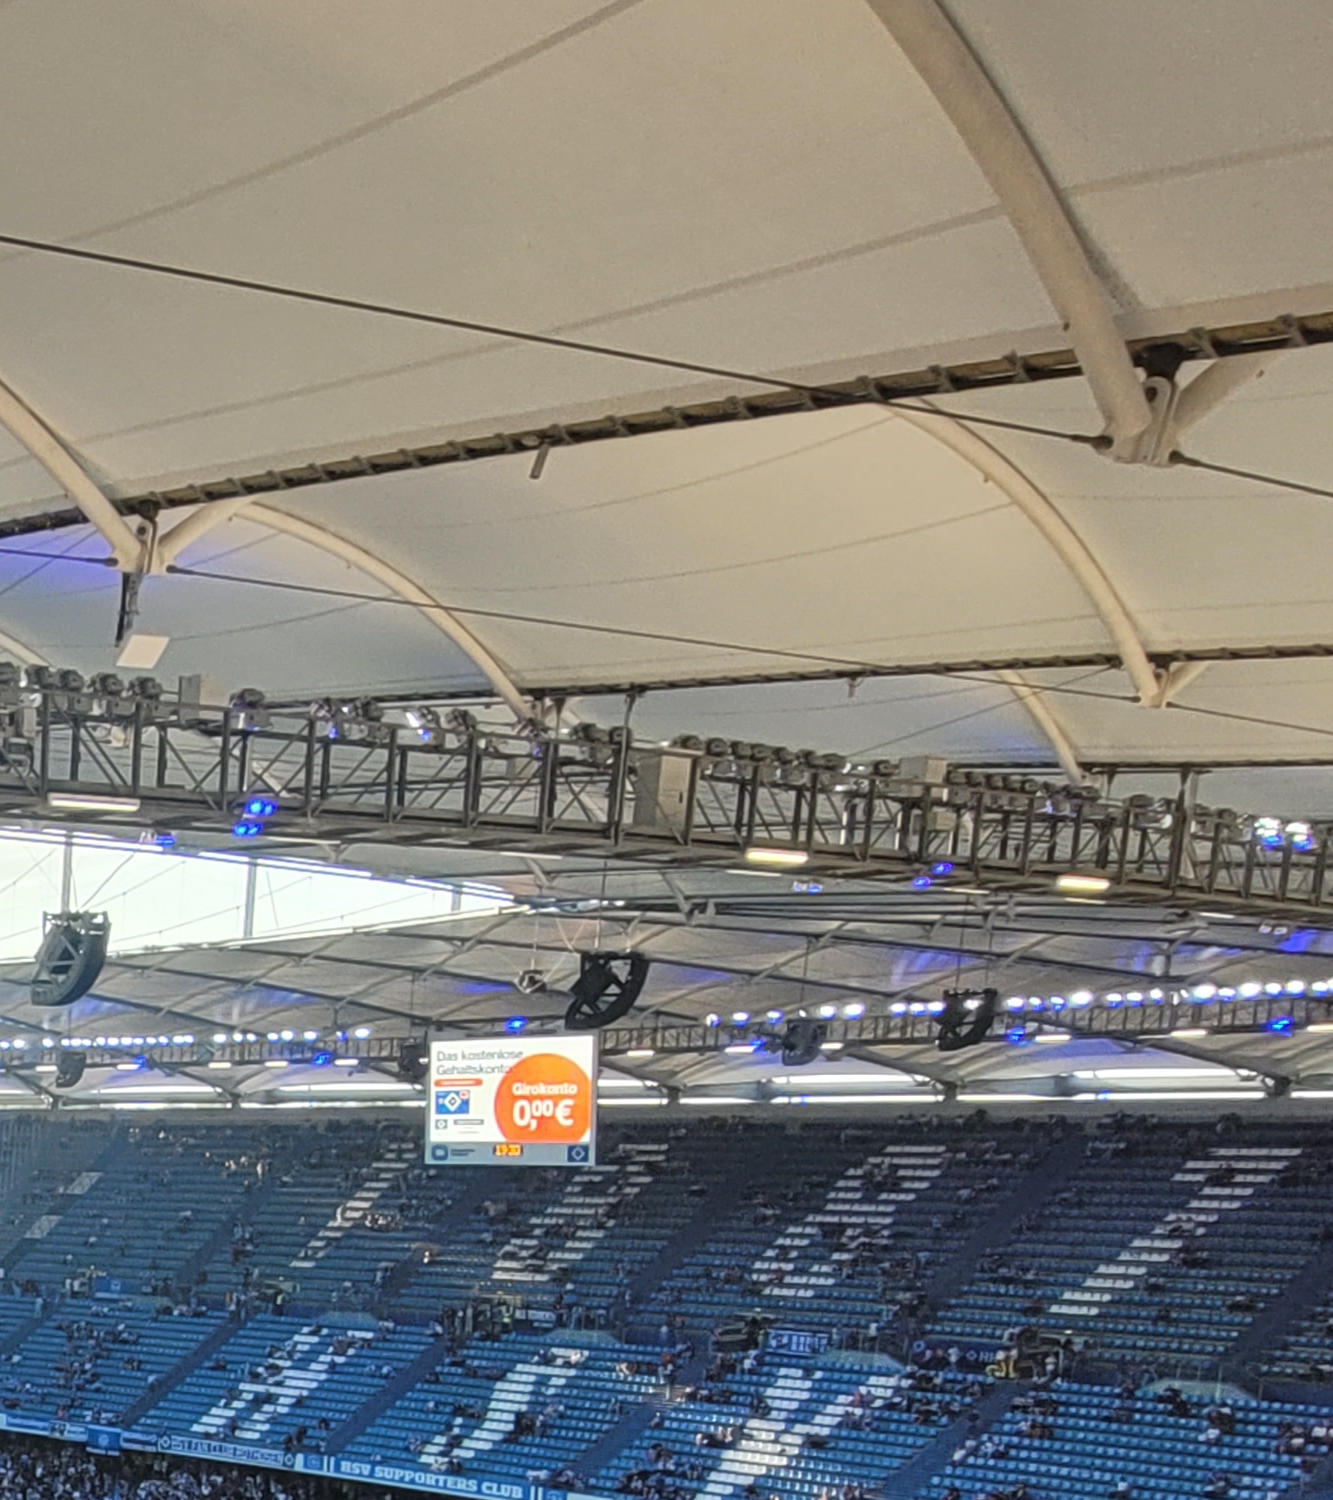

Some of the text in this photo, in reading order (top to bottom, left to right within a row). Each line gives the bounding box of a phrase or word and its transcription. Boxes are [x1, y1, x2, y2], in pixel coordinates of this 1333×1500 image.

[436, 1049, 523, 1062] Das kostenlose
[512, 1082, 578, 1096] Girokonto
[340, 1460, 523, 1499] HSV SUPPORTERS CLUB
